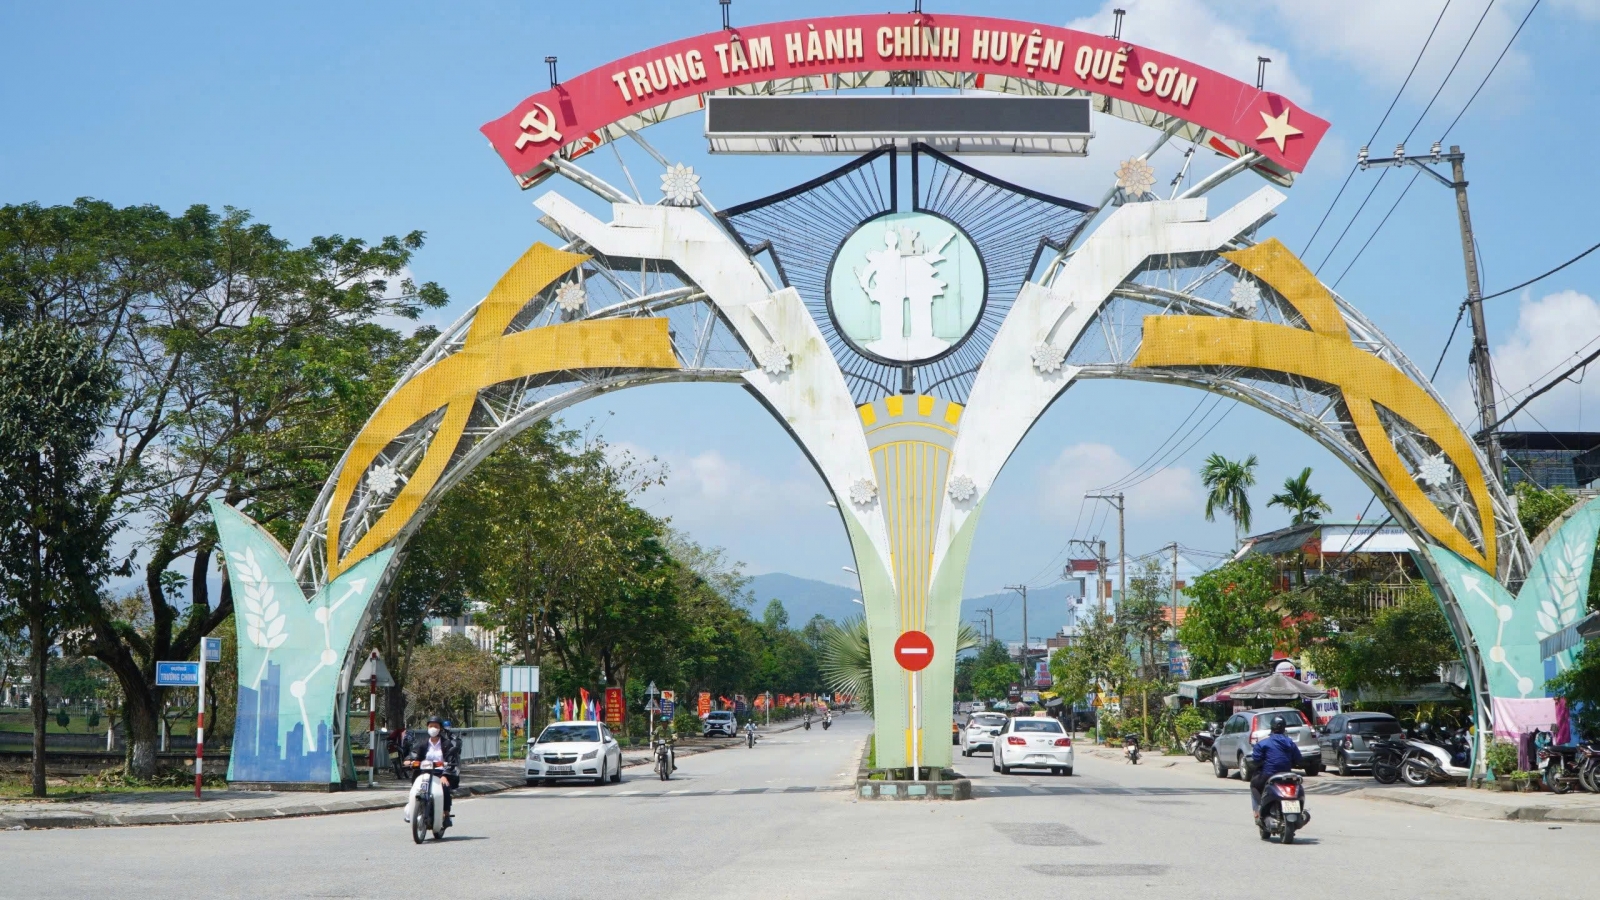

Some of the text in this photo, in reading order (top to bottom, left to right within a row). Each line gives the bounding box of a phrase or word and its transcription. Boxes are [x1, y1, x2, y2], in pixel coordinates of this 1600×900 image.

[611, 19, 1199, 107] TRUNG TÂM HÀNH CHÍNH HUYỆN QUẾ SƠN
